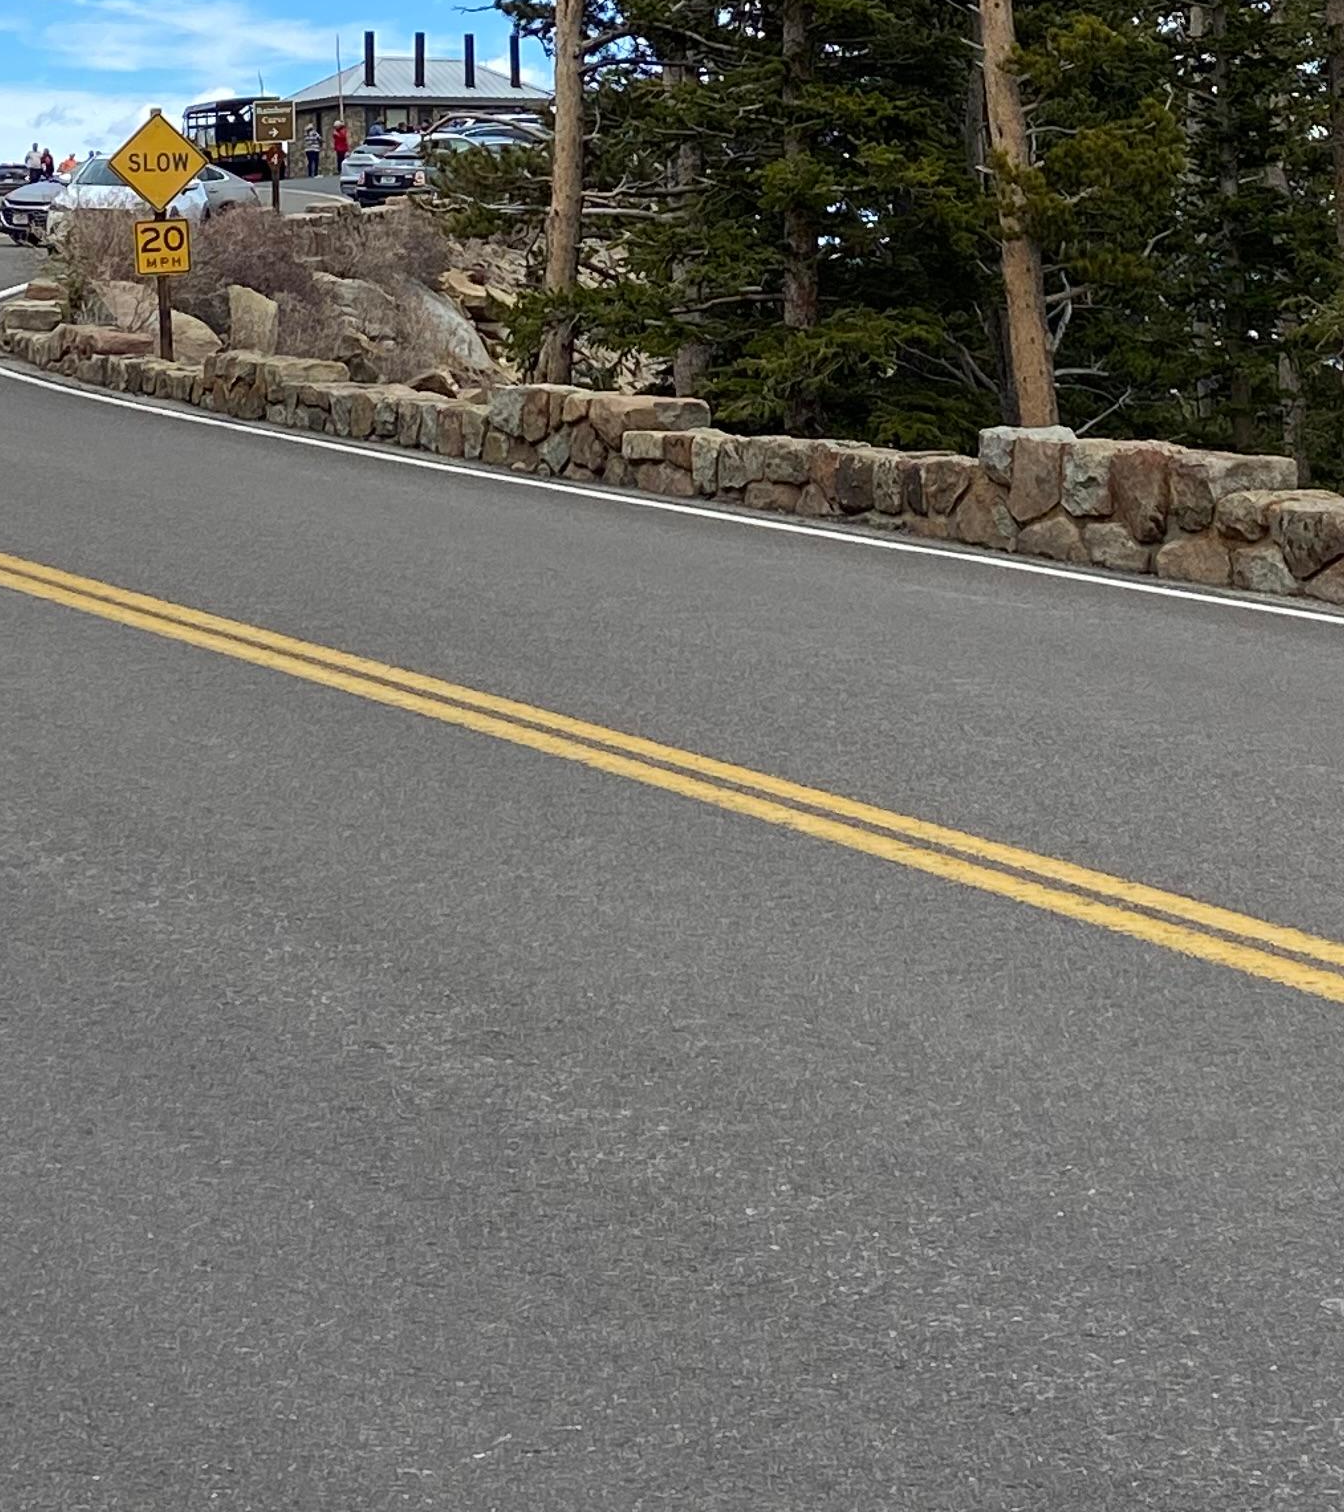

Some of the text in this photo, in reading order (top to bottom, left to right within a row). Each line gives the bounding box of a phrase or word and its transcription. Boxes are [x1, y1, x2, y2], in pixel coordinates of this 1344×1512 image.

[128, 152, 189, 172] SLOW
[140, 226, 185, 253] 20
[146, 256, 182, 268] MPH
